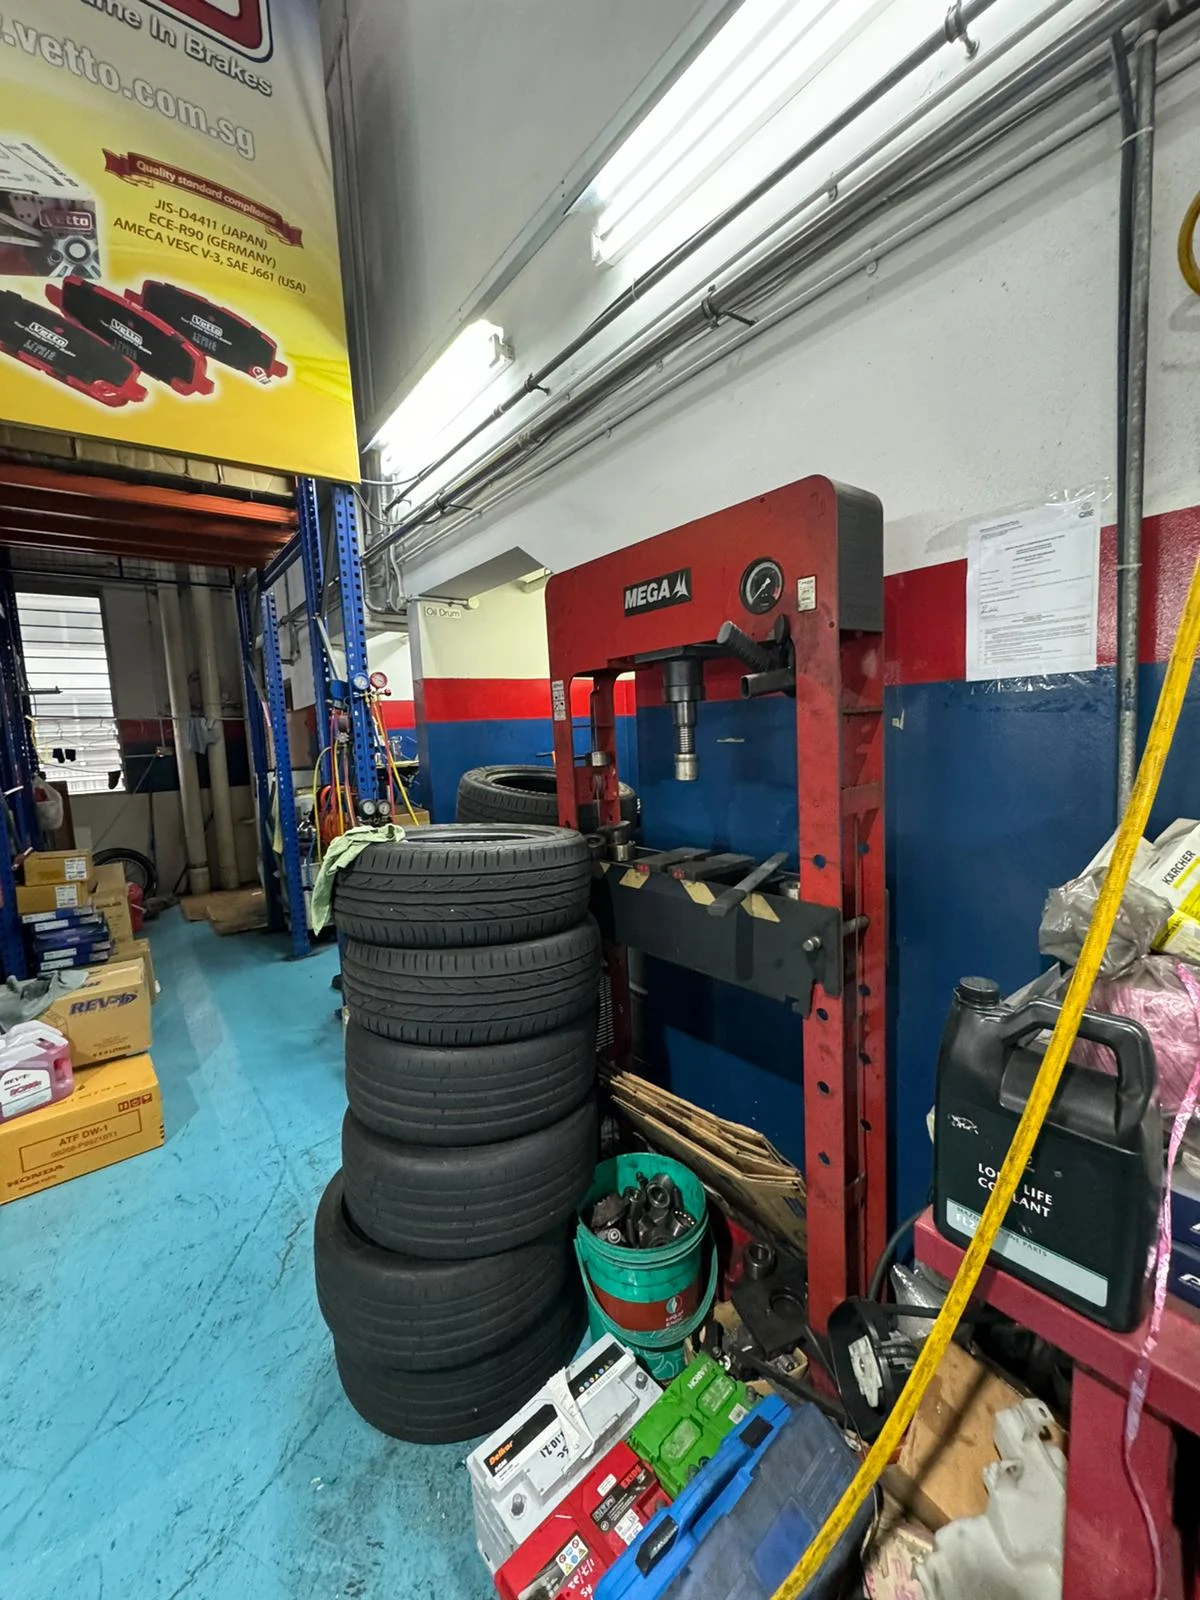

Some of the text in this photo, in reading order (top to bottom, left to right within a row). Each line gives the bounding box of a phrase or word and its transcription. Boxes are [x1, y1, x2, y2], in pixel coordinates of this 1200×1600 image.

[150, 20, 177, 49] In
[184, 36, 273, 97] Brakes
[0, 14, 257, 161] .vetto.com.sg
[136, 159, 277, 225] Quality standard compliance
[149, 212, 277, 269] ECE-R90 (GERMANY)
[155, 199, 268, 250] JIS-D4411 (JAPAN)
[113, 217, 306, 295] AMECA VESC V-3, SAE J661 (USA)
[426, 607, 460, 617] Oil Drum
[624, 579, 670, 610] MEGA
[58, 1124, 109, 1147] ATF DW-1
[7, 1164, 65, 1188] HONDA
[978, 1162, 1053, 1206] LO LIFE
[977, 1176, 1051, 1218] COLANT
[955, 1213, 979, 1230] FL2
[1022, 1238, 1048, 1257] PARTS
[488, 1440, 514, 1466] Delkor
[620, 1463, 642, 1489] EXIDE
